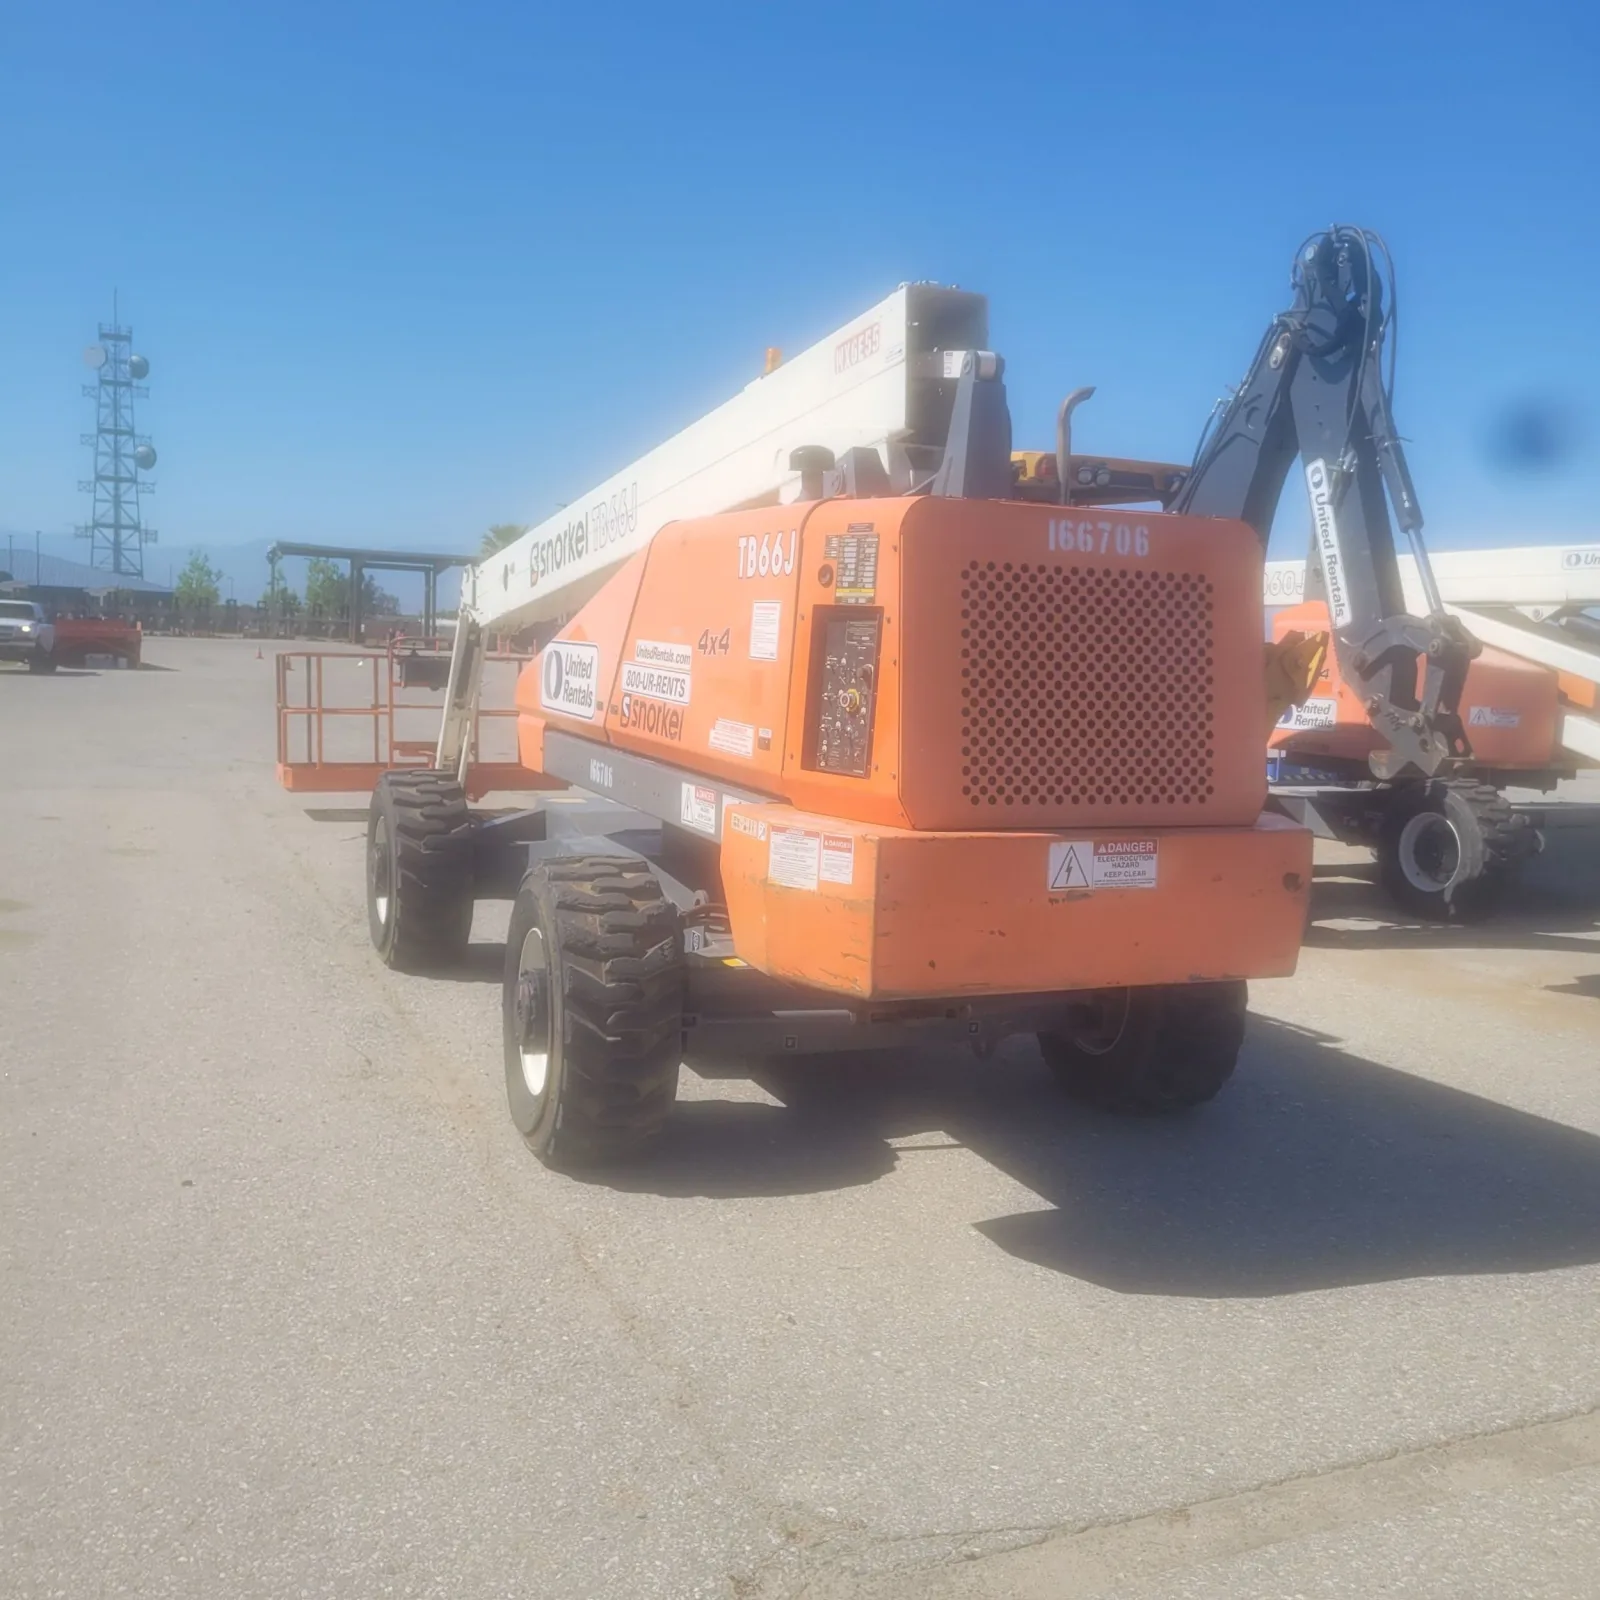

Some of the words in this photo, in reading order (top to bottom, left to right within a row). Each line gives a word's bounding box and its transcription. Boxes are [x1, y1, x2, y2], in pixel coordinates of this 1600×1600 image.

[540, 511, 588, 578] snorkel
[592, 481, 637, 552] TB66J
[738, 529, 797, 579] TB66J
[1315, 493, 1335, 549] United
[1326, 554, 1345, 617] Rentals
[636, 645, 691, 665] UnitedRentals.com
[698, 627, 731, 656] 4x4
[565, 652, 593, 679] United
[563, 680, 593, 708] Rentals
[626, 669, 686, 698] 800-UR-RENTS
[1294, 715, 1333, 728] Rentals
[1296, 704, 1331, 715] United
[1097, 855, 1154, 863] ELECTROCUTION
[1107, 842, 1154, 853] DANGER
[1123, 870, 1147, 878] CLEAR
